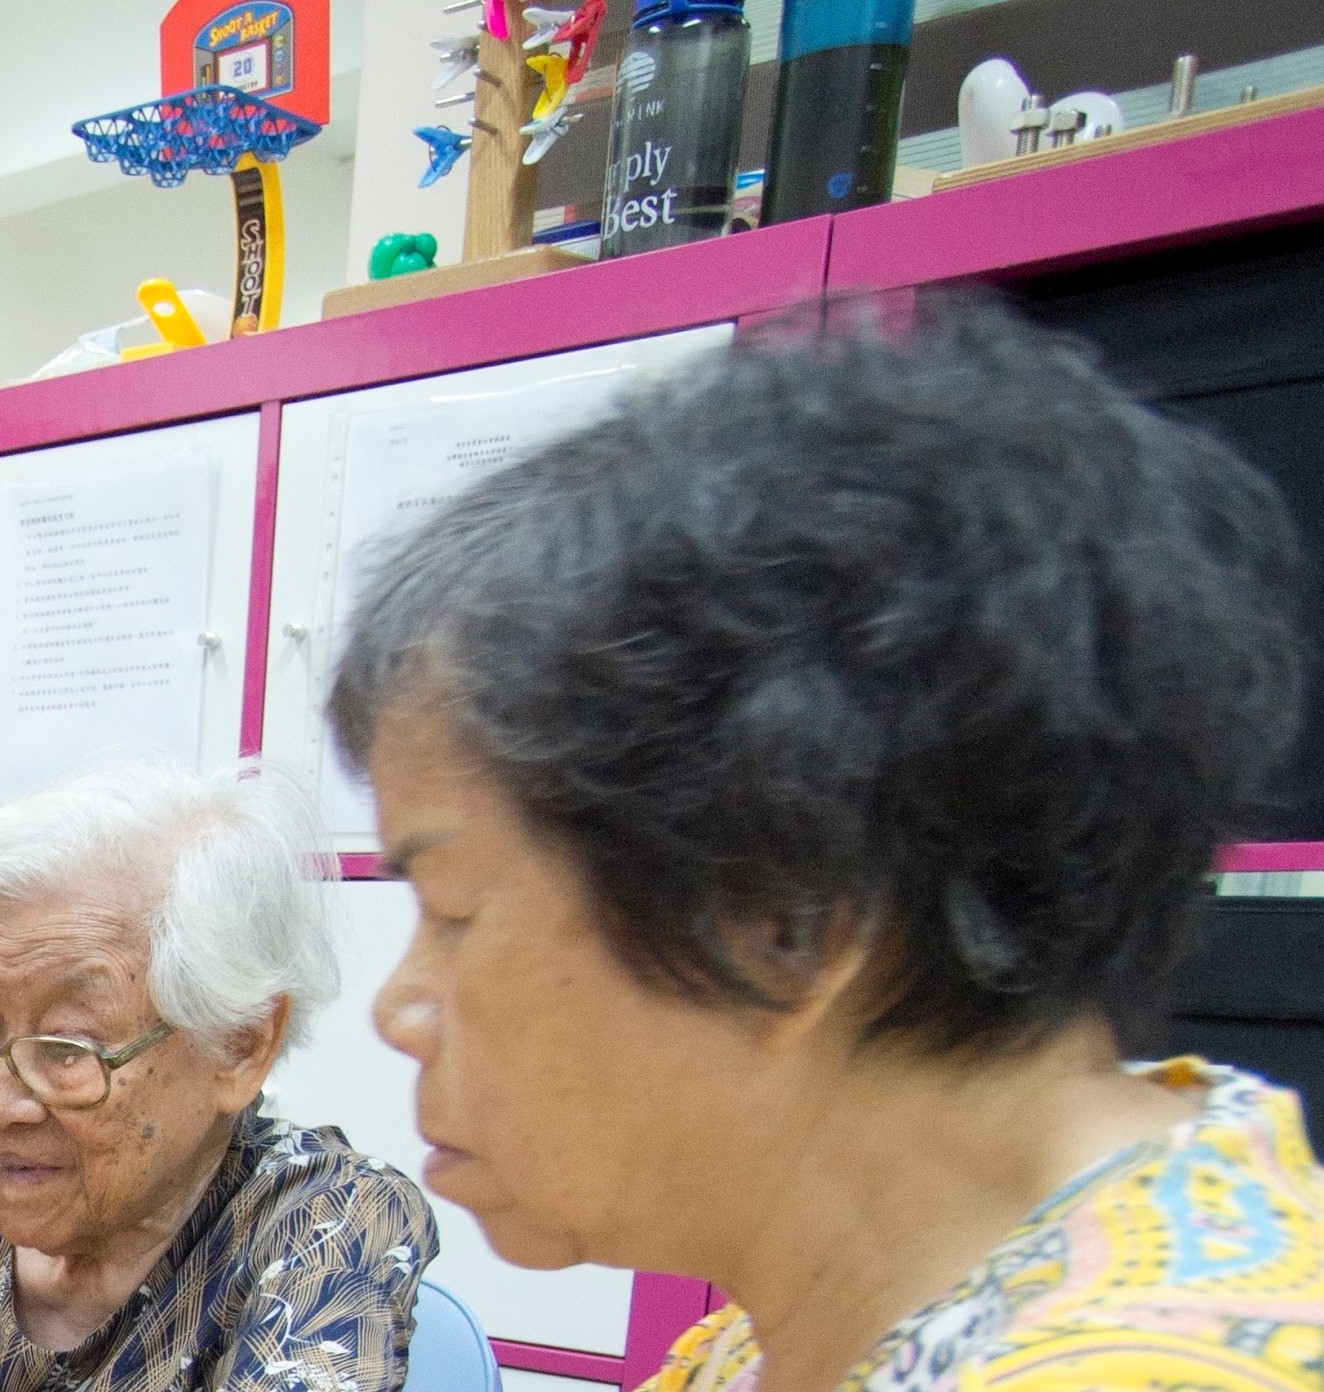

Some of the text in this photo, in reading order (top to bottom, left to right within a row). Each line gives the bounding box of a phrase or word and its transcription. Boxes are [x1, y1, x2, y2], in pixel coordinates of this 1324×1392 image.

[210, 11, 253, 48] SHOOT A
[239, 11, 280, 44] BASKET
[233, 58, 253, 77] 20
[623, 99, 665, 124] RINK
[602, 188, 678, 242] Best
[241, 219, 264, 316] SHOOT
